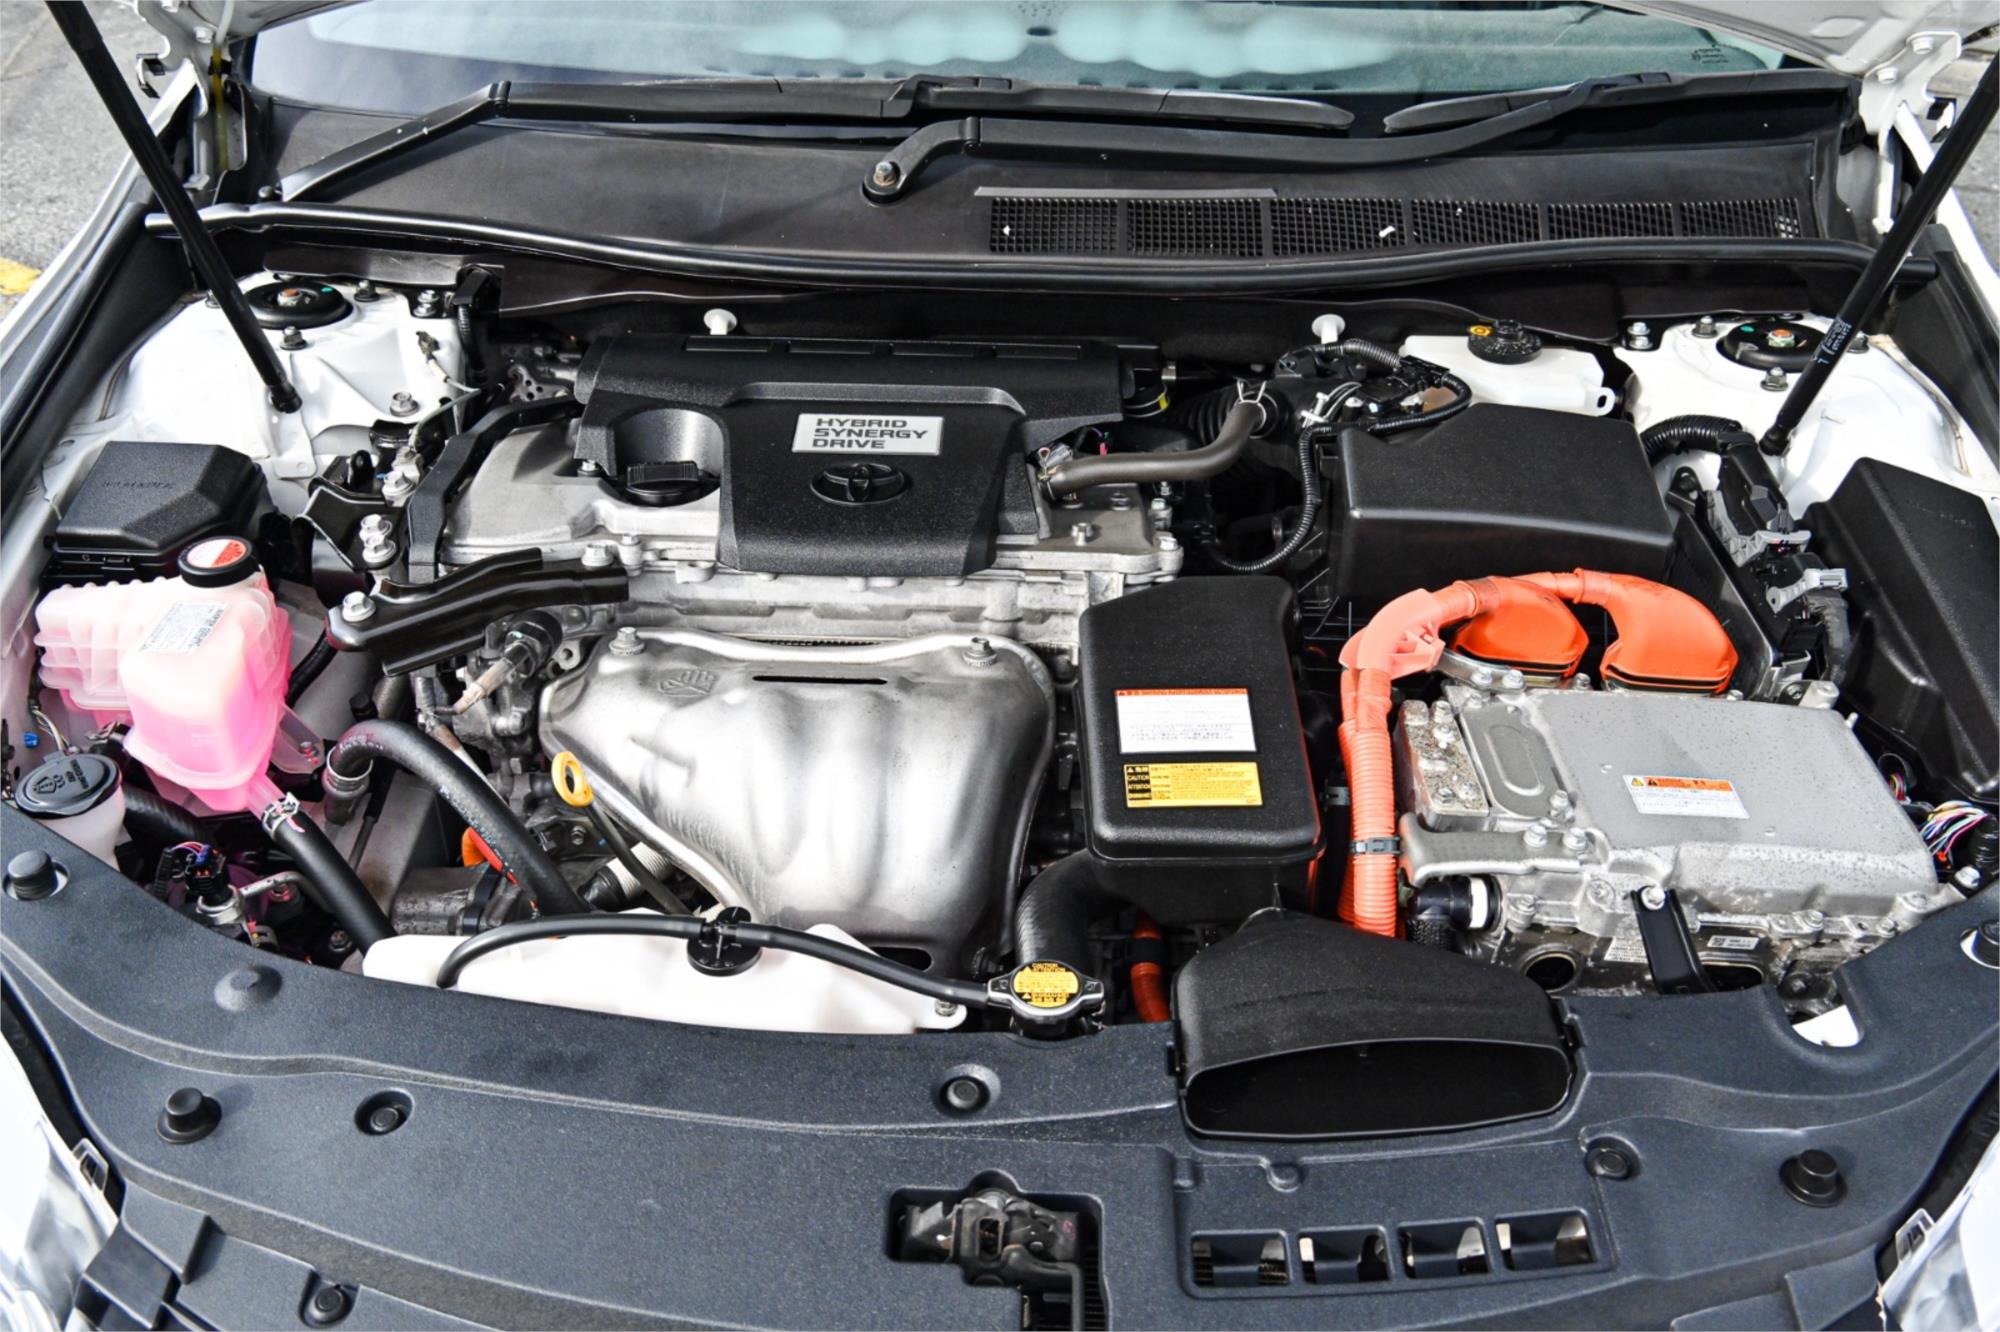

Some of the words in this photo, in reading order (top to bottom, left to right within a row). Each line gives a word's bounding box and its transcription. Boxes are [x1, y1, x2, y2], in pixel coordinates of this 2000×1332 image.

[816, 418, 908, 428] HYBRID
[814, 428, 929, 439] SYNERGY
[812, 438, 886, 449] DRIVE
